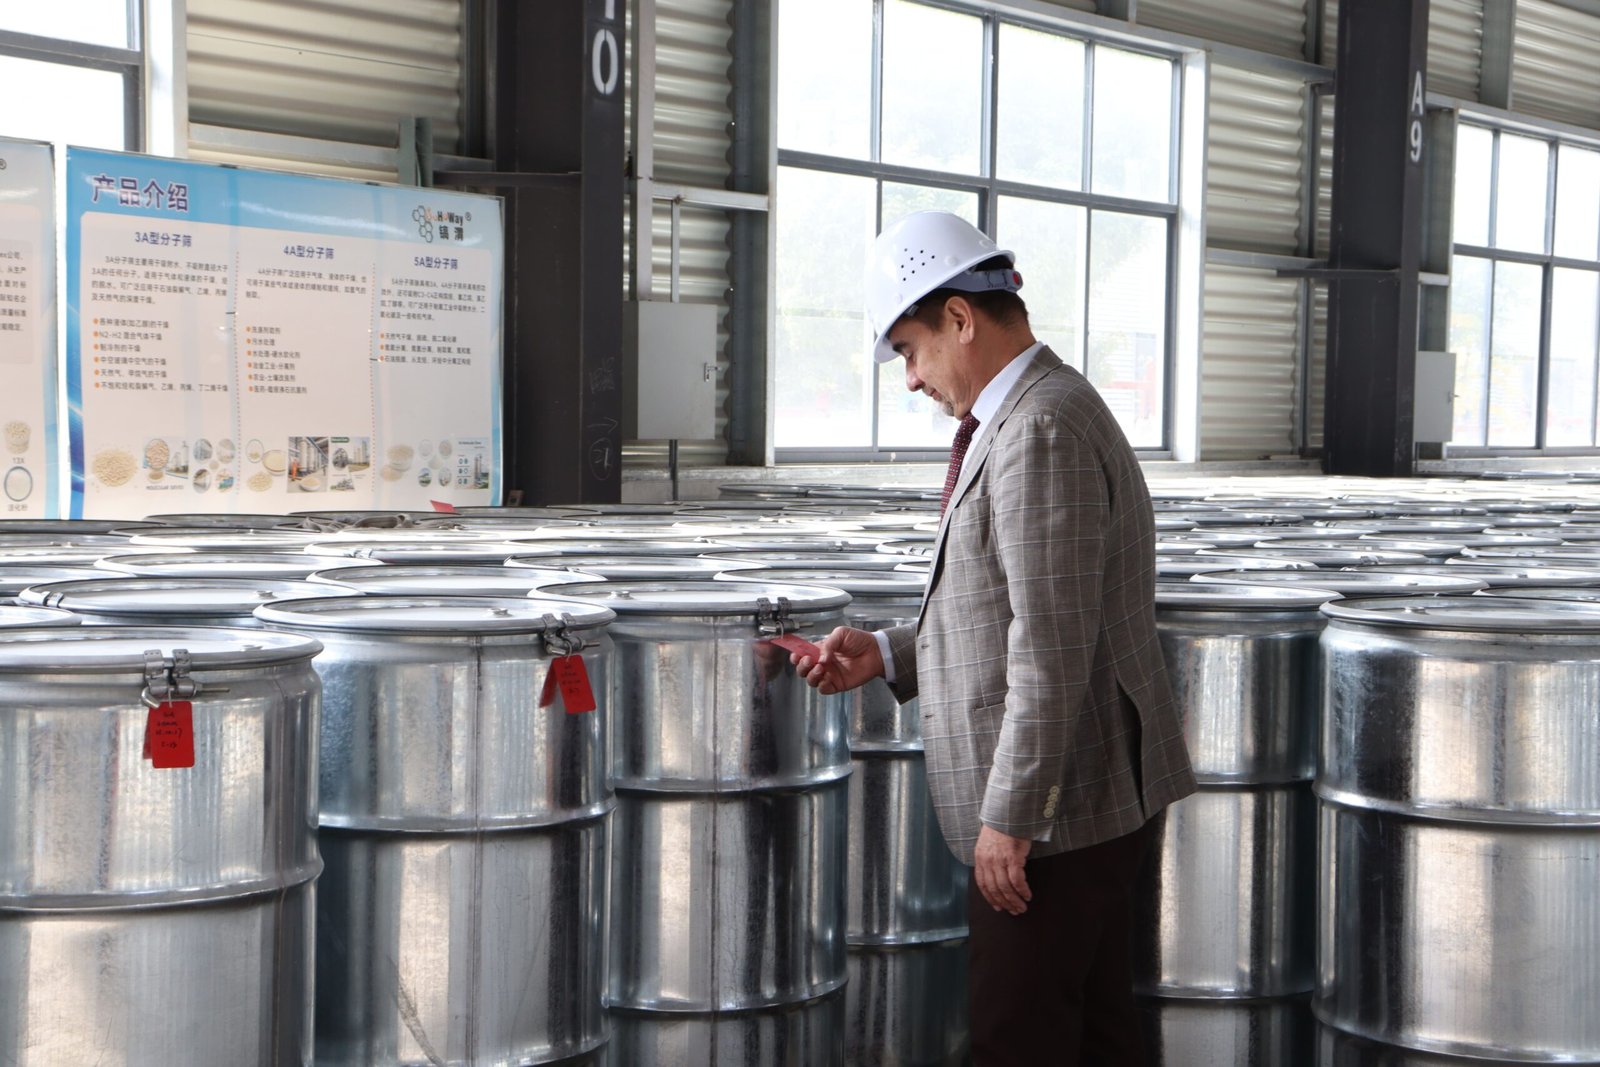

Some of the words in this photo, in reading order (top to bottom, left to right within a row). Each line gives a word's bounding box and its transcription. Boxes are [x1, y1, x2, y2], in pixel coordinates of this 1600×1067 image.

[1410, 70, 1424, 163] A9
[92, 174, 189, 213] 产品介绍
[134, 231, 192, 247] 3A型分子筛
[284, 245, 335, 259] 4A型分子筛
[414, 256, 458, 270] 5A型分子筛
